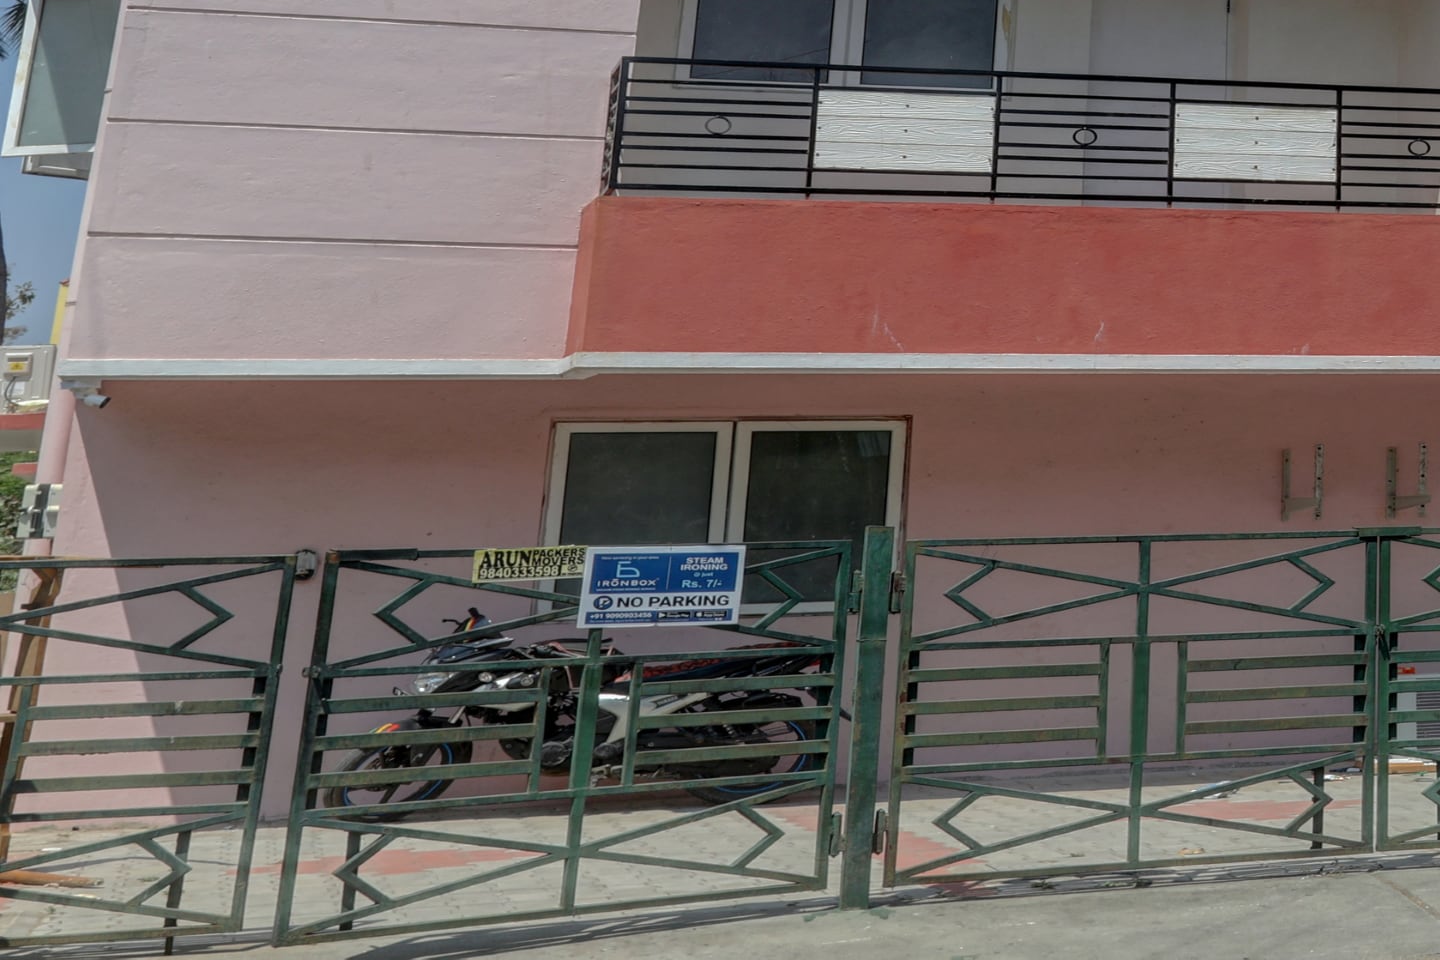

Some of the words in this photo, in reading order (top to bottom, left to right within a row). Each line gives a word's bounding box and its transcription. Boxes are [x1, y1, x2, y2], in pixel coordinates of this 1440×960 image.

[480, 550, 533, 569] ARUN
[533, 548, 585, 558] PACKERS
[533, 556, 585, 566] MOVERS
[479, 565, 559, 579] 9840333598
[680, 563, 729, 571] IRONING
[681, 579, 702, 588] Rs.
[616, 596, 643, 608] NO
[648, 594, 729, 608] PARKING
